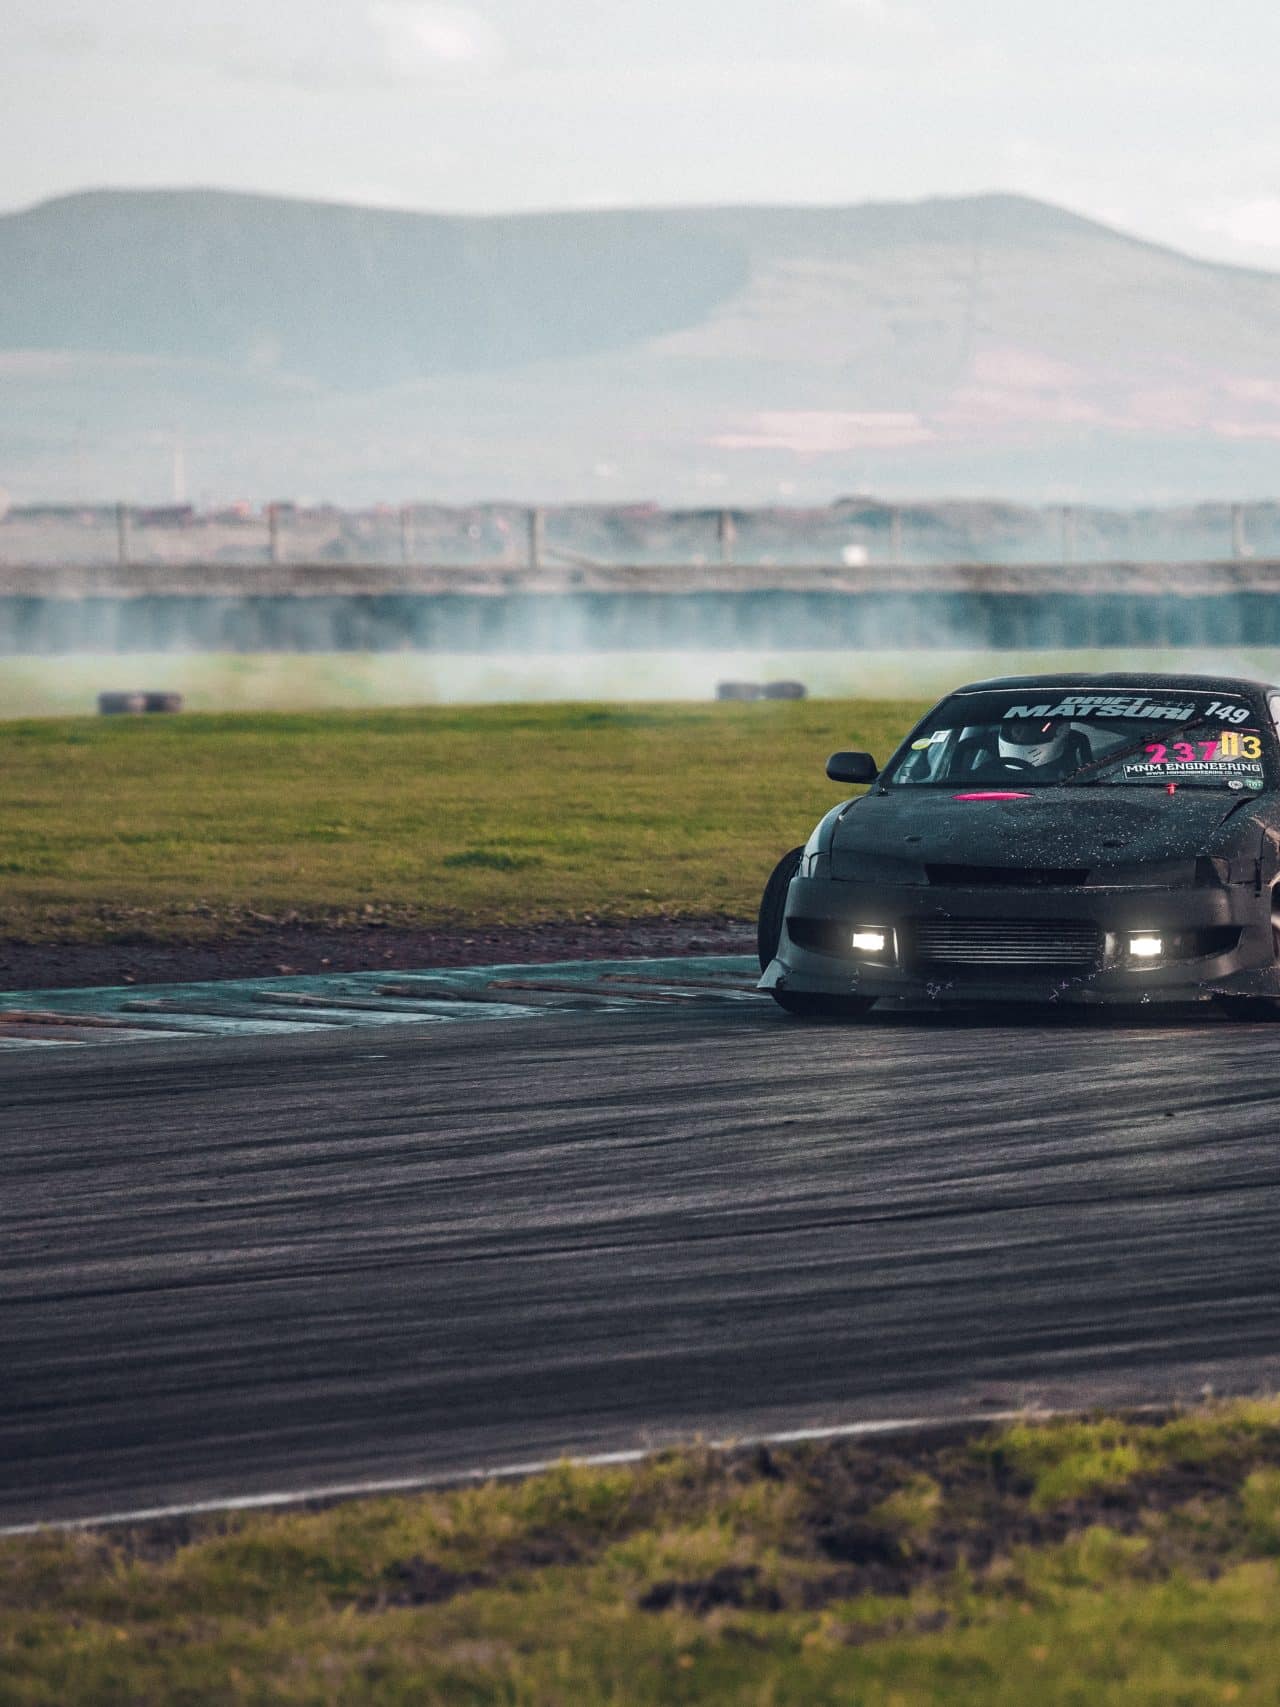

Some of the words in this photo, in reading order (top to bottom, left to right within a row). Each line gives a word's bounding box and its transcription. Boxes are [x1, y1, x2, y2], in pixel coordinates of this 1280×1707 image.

[1061, 696, 1153, 705] DRIFT
[1003, 704, 1196, 720] MATSURI
[1205, 702, 1250, 723] 149
[1145, 741, 1219, 764] 237
[1126, 764, 1162, 773] MNM
[1167, 762, 1261, 772] ENGINEERING
